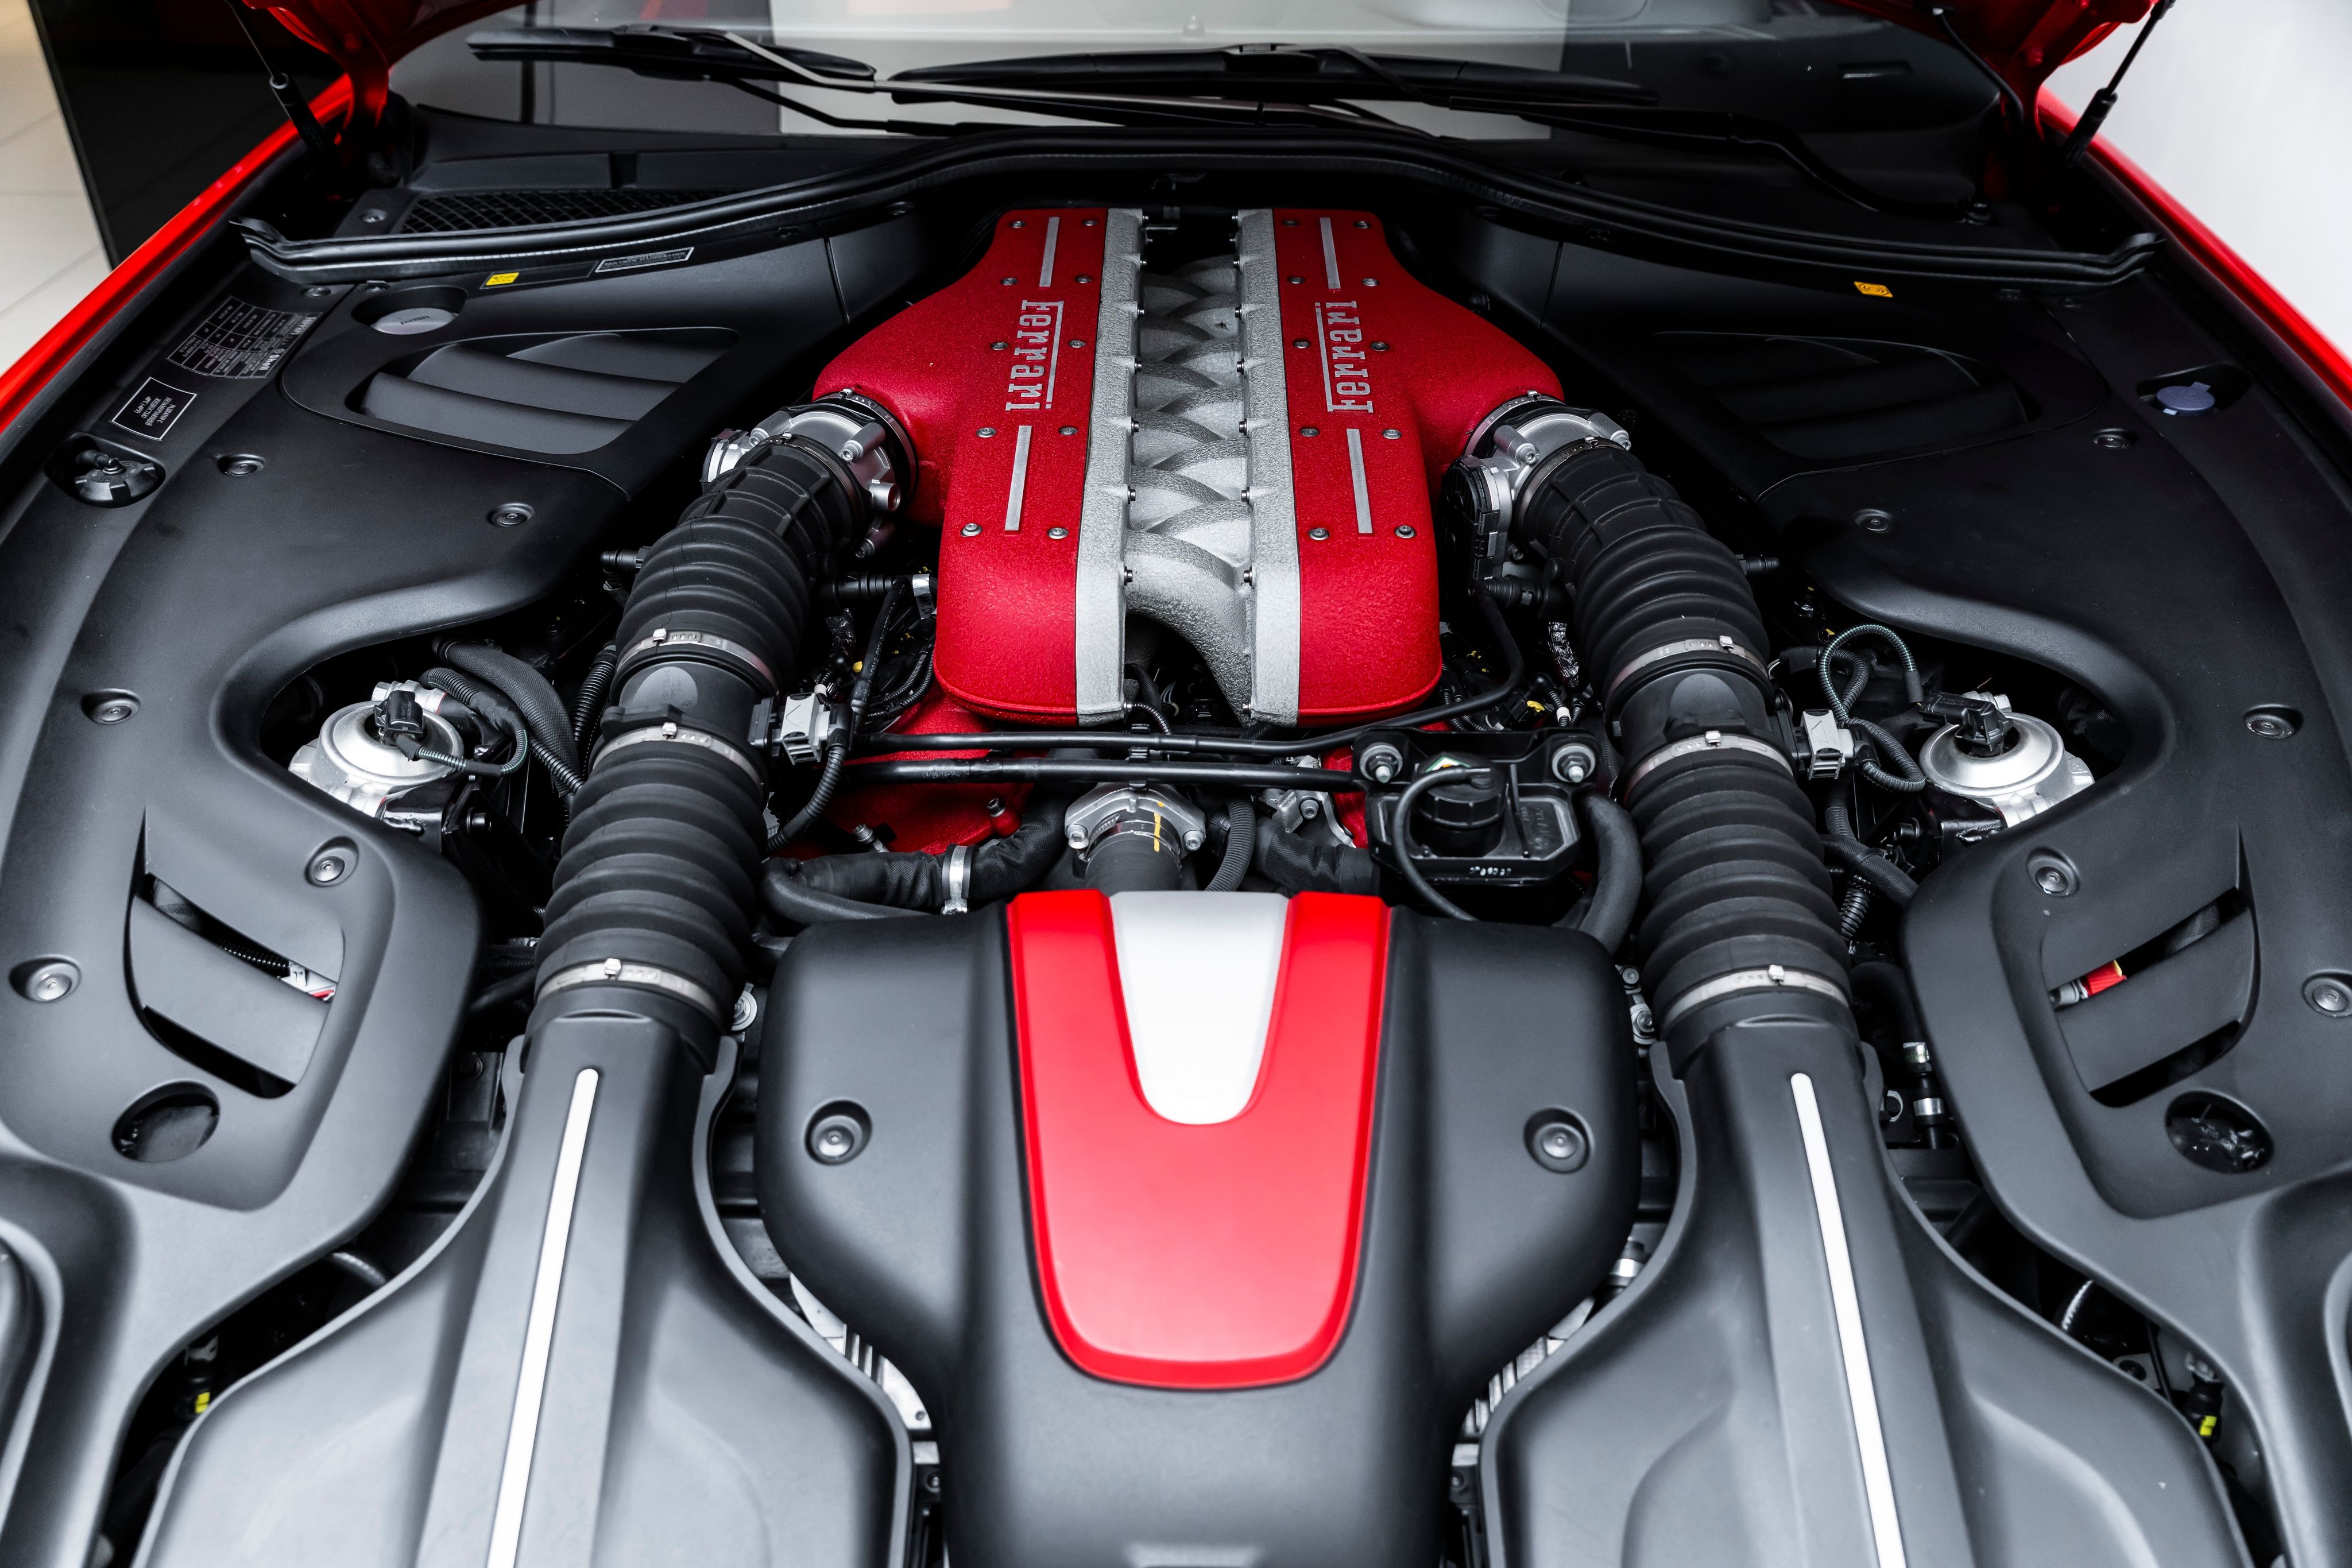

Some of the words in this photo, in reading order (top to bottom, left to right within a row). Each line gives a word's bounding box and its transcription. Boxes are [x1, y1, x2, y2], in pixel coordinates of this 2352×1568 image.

[258, 354, 280, 370] Shell
[1005, 300, 1064, 411] Ferrari
[1314, 301, 1374, 413] Ferrari
[159, 404, 176, 421] РАДИАТОР
